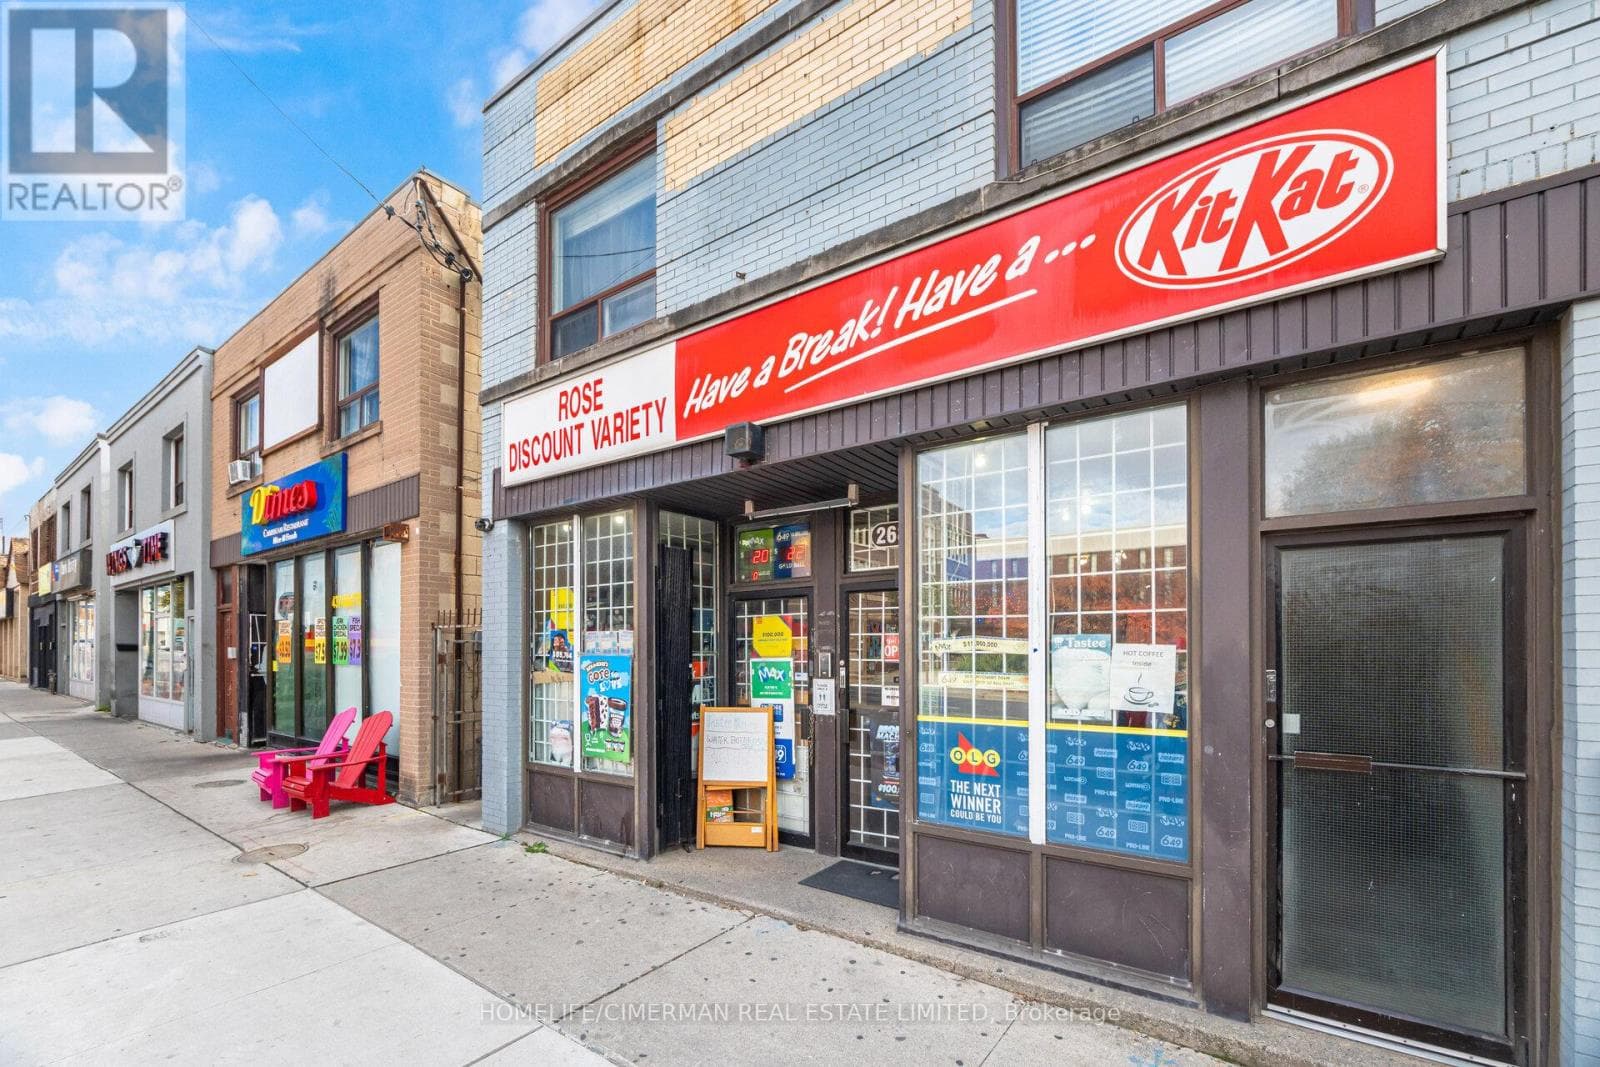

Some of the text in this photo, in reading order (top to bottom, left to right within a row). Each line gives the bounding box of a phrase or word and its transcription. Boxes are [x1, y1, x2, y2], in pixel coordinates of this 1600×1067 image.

[683, 366, 751, 418] Have
[753, 355, 776, 388] a
[778, 286, 898, 379] Break!
[894, 254, 1002, 330] Have
[558, 378, 604, 422] ROSE
[508, 397, 667, 473] DISCOUNT VARIETY
[876, 525, 899, 545] 26
[752, 549, 769, 564] 20
[884, 645, 898, 657] OP
[1068, 638, 1107, 648] Tastee
[758, 665, 785, 682] MAX
[951, 749, 998, 766] OLG
[1127, 759, 1148, 772] 649
[950, 780, 971, 794] THE
[974, 782, 1001, 798] NEXT
[950, 793, 1001, 814] WINNER
[950, 809, 1002, 824] COULD BE YOU
[1160, 834, 1183, 848] 649
